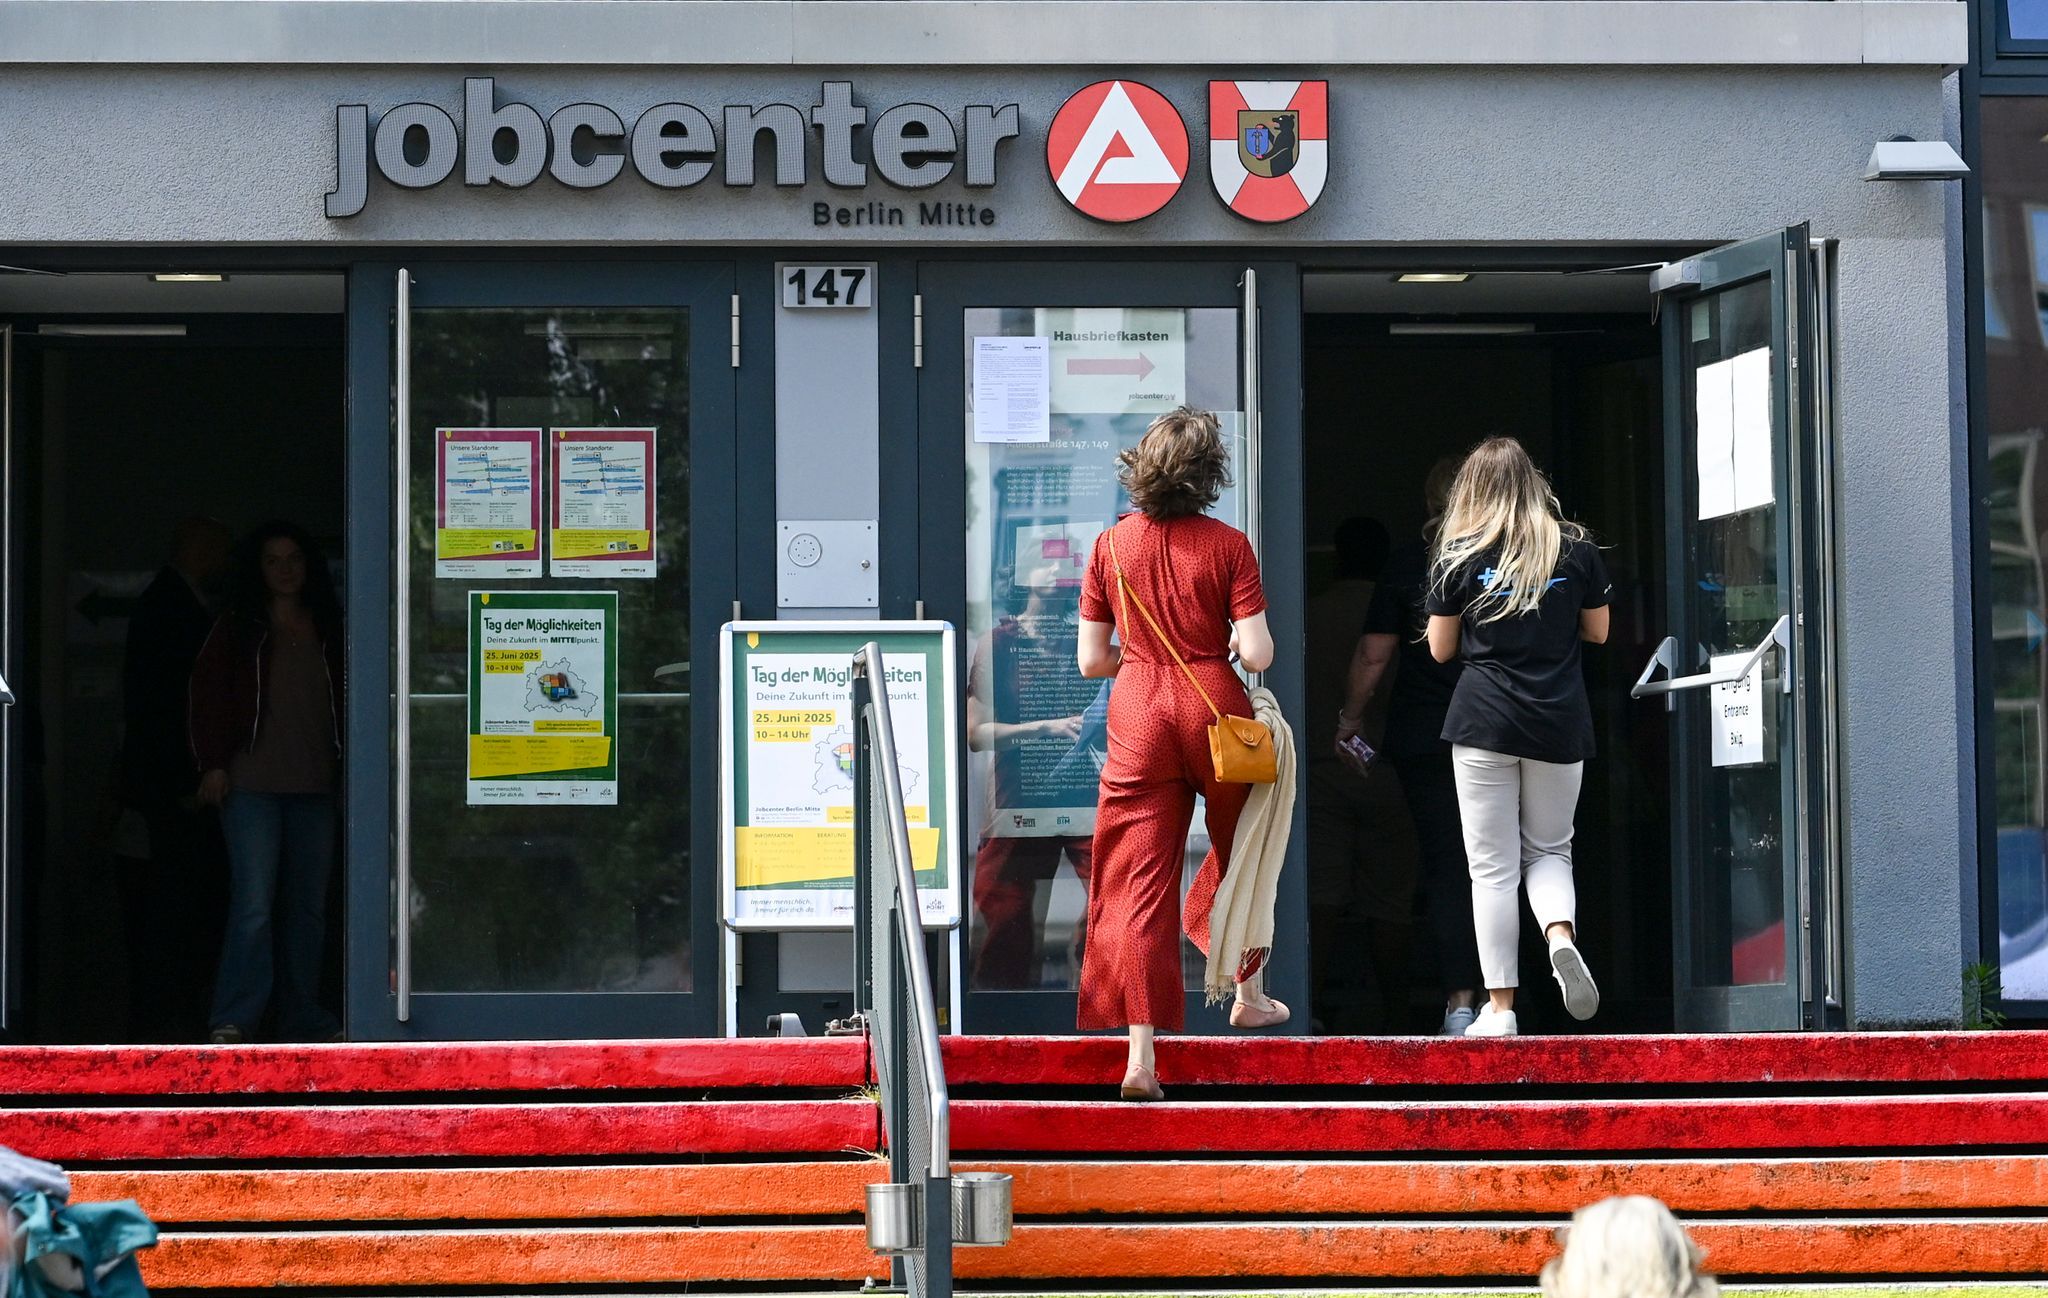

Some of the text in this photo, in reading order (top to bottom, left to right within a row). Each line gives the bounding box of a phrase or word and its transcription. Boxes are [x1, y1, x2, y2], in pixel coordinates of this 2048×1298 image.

[325, 77, 1019, 219] jobcenter
[813, 202, 996, 226] Berlin Mitte
[788, 268, 868, 307] 147
[1054, 330, 1169, 342] Hausbriefkasten
[1128, 393, 1164, 401] jobcenter
[484, 617, 602, 633] Tag der Möglichkeiten
[509, 636, 538, 644] Zukunft
[550, 636, 600, 646] MITTElpunkt.
[486, 652, 539, 660] 25. Juni 2025
[751, 665, 777, 687] Tag
[781, 667, 809, 683] der
[756, 691, 785, 701] Deine
[789, 691, 829, 701] Zukunft
[832, 691, 845, 701] im
[1724, 704, 1749, 718] Entrance
[756, 713, 832, 723] 25. Juni 2025
[756, 731, 767, 739] 10
[777, 731, 788, 739] 14
[792, 730, 809, 739] Uhr
